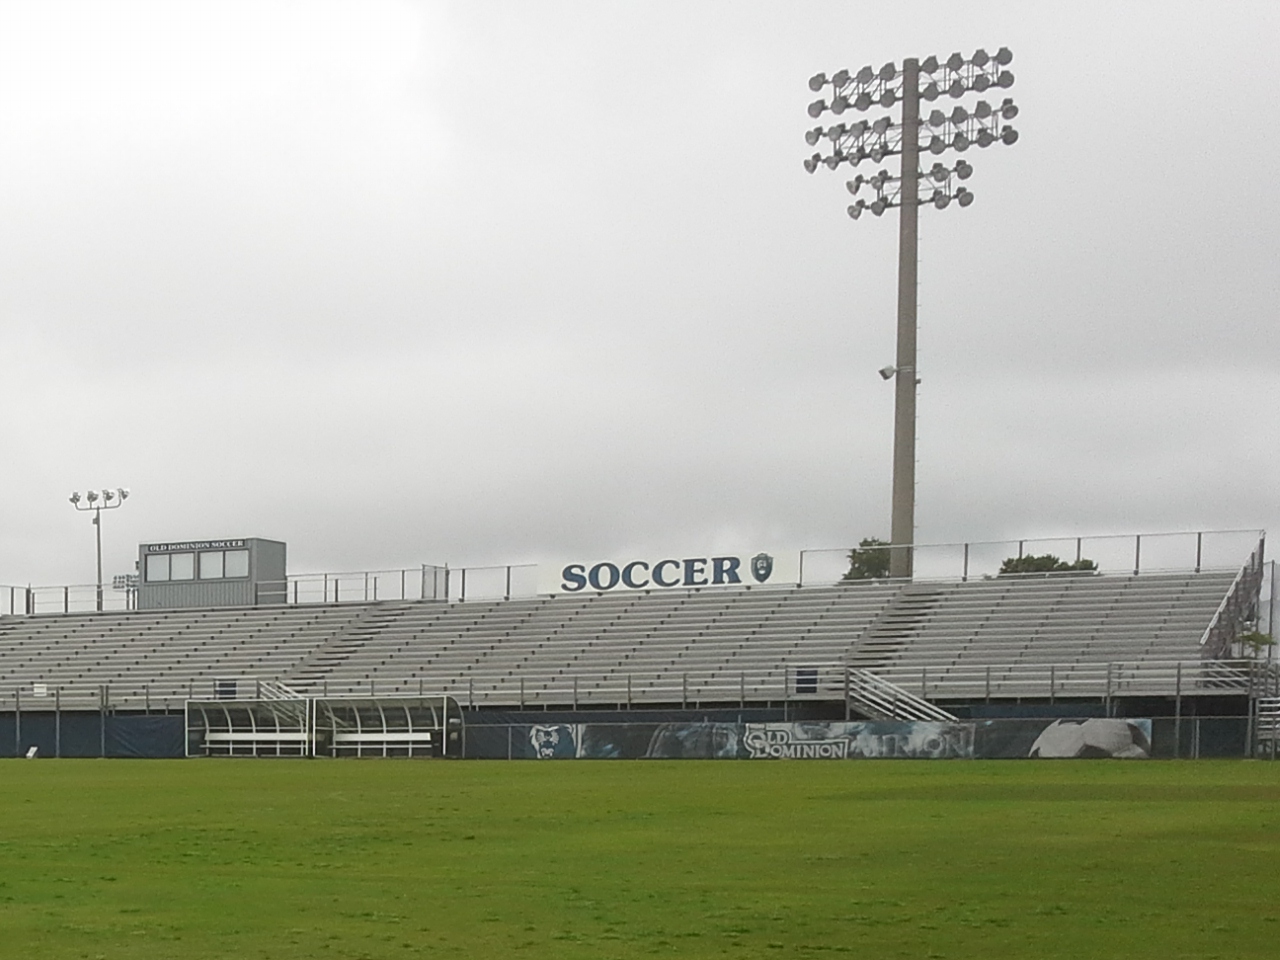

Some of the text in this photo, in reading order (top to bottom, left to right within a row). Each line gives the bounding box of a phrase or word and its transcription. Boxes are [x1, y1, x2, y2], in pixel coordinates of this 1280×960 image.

[150, 540, 243, 552] OLD DOMINION SOCCER
[561, 556, 742, 592] SOCCER
[747, 731, 788, 746] OLD
[754, 740, 844, 758] DOMINION
